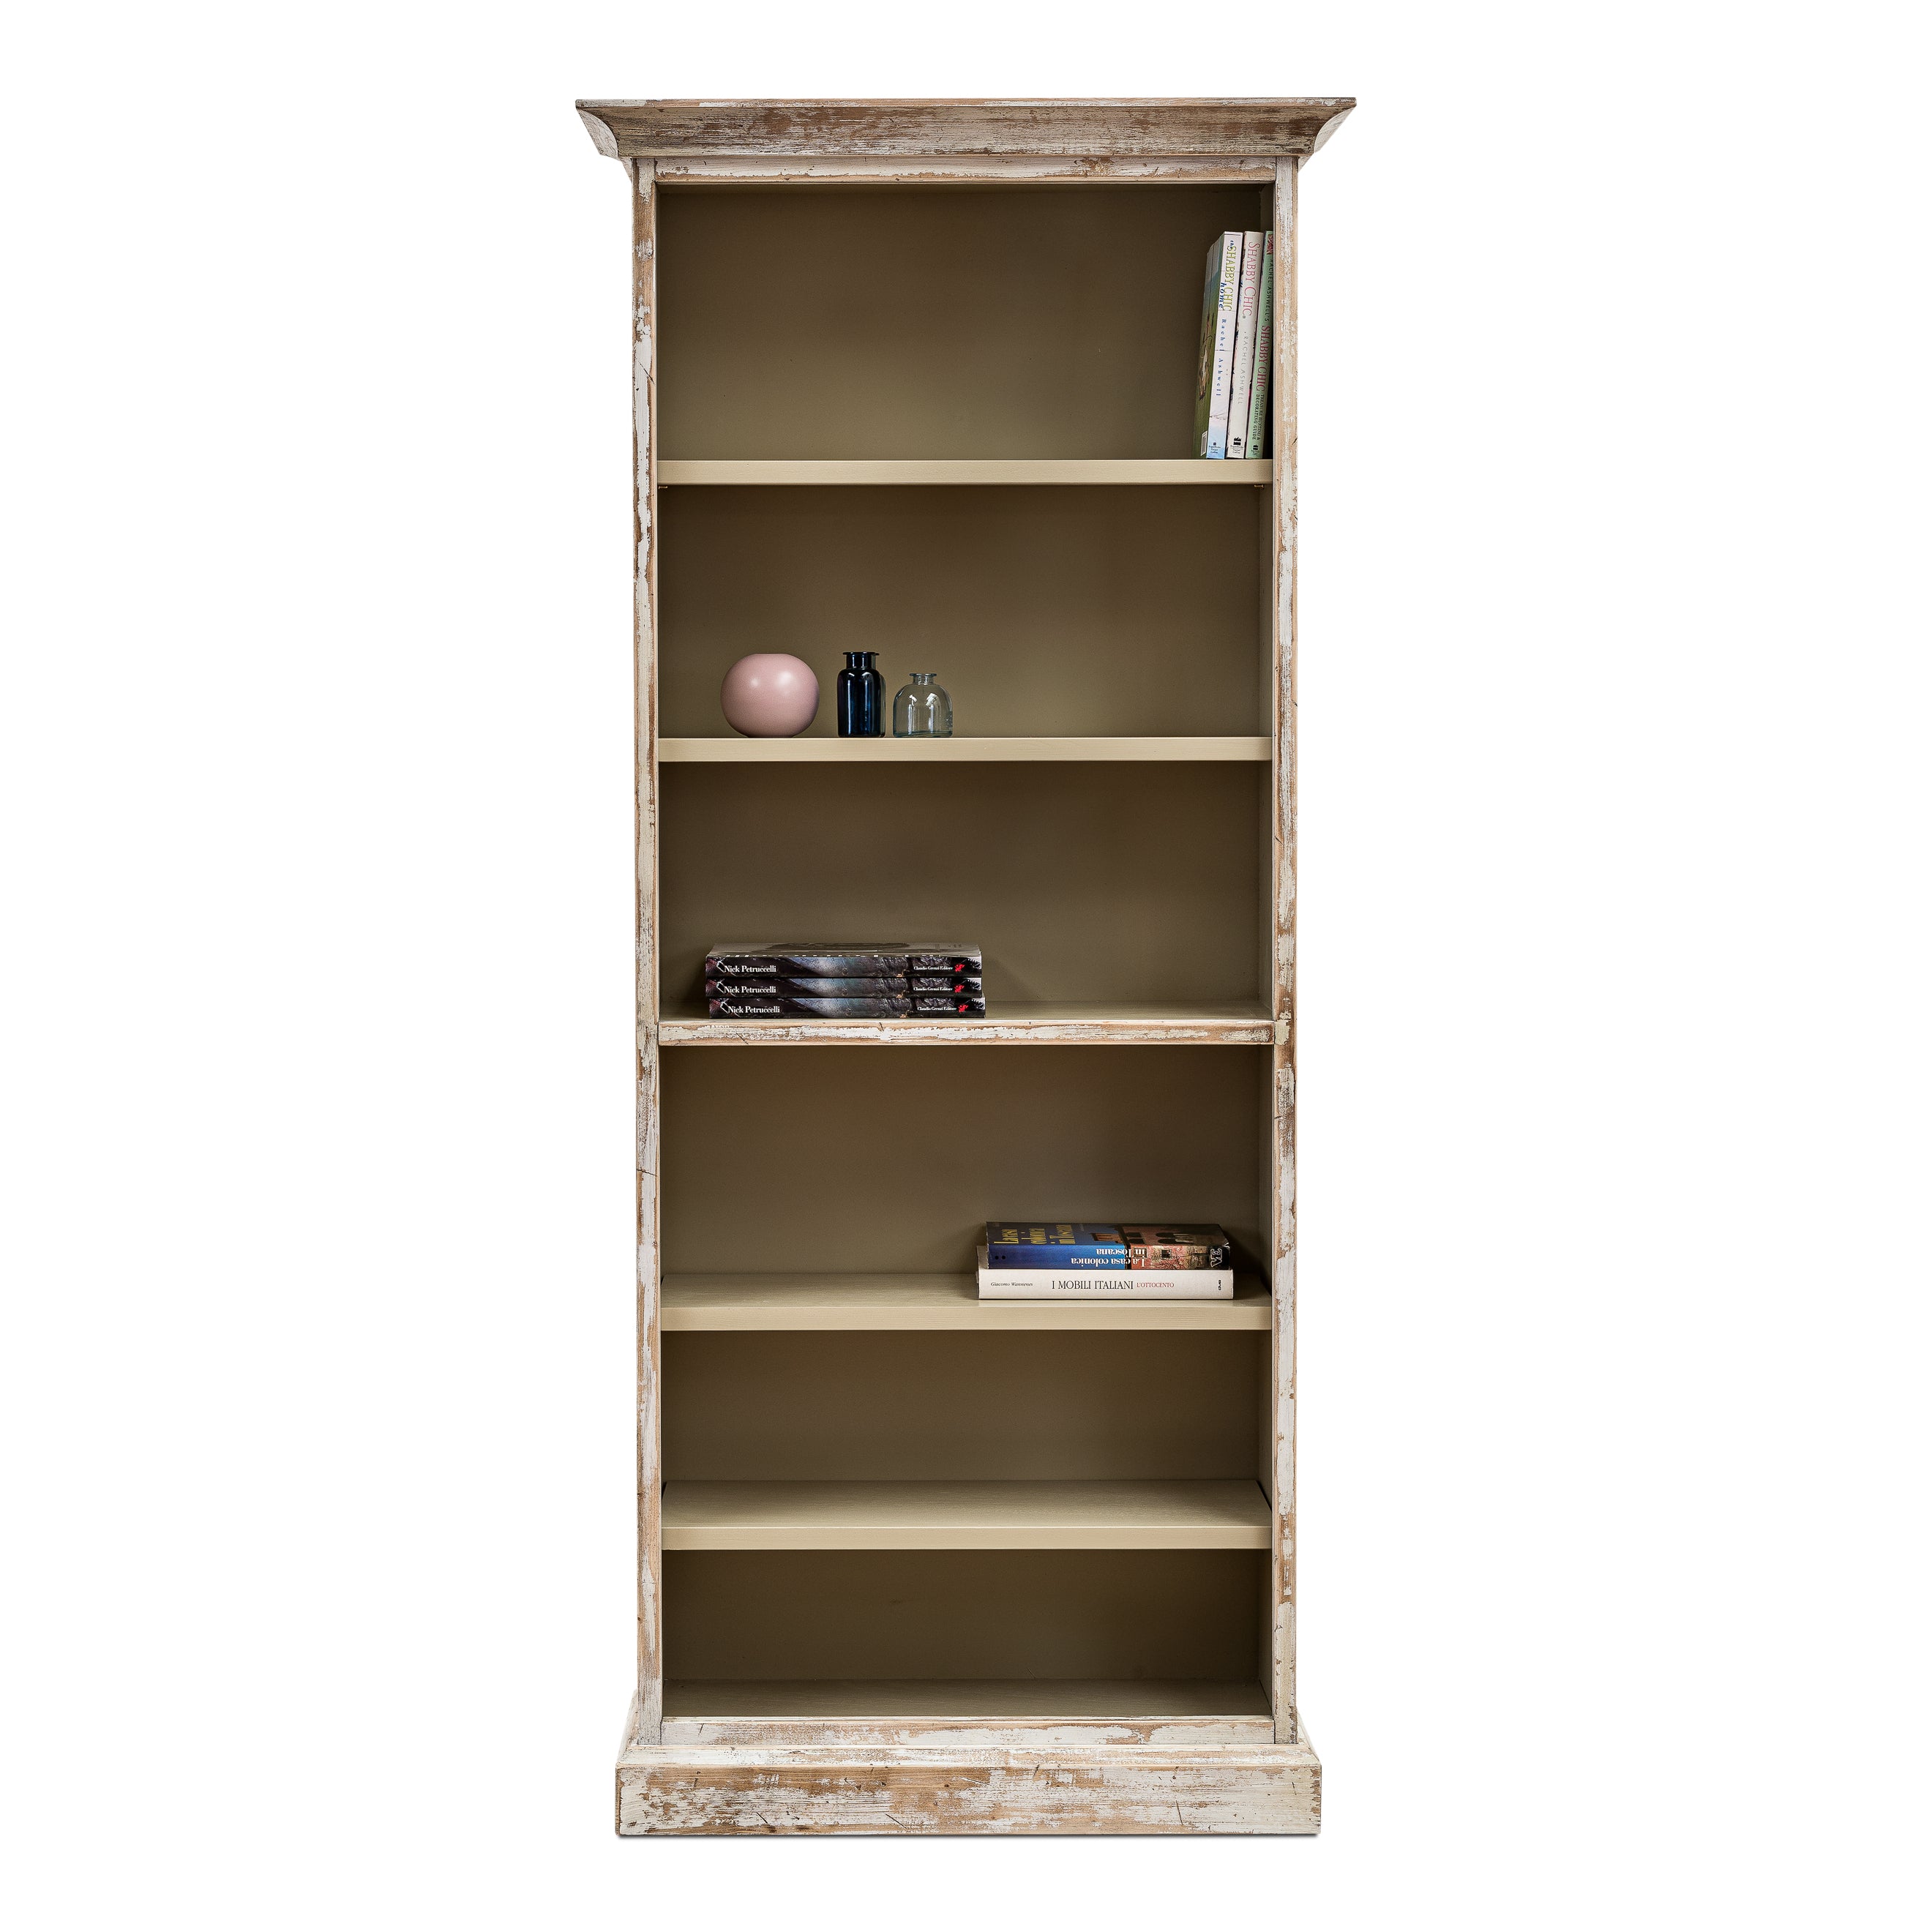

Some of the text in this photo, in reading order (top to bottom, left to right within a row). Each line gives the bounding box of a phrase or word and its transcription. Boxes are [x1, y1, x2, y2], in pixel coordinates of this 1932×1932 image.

[1246, 242, 1260, 283] SHABBY
[1223, 246, 1237, 311] SHABBY CHIC
[1218, 282, 1227, 308] home
[1256, 325, 1271, 392] SHABBY CHIC
[1238, 370, 1247, 405] ASHWELL
[724, 965, 776, 973] Nick Petruccelli
[727, 1006, 780, 1014] Nick Petruccelli
[1096, 1248, 1134, 1258] Toscana
[1135, 1248, 1145, 1258] in
[1071, 1258, 1109, 1267] colonica
[1134, 1259, 1145, 1268] La
[1058, 1281, 1091, 1289] MOBILI
[1094, 1281, 1134, 1289] ITALIANI
